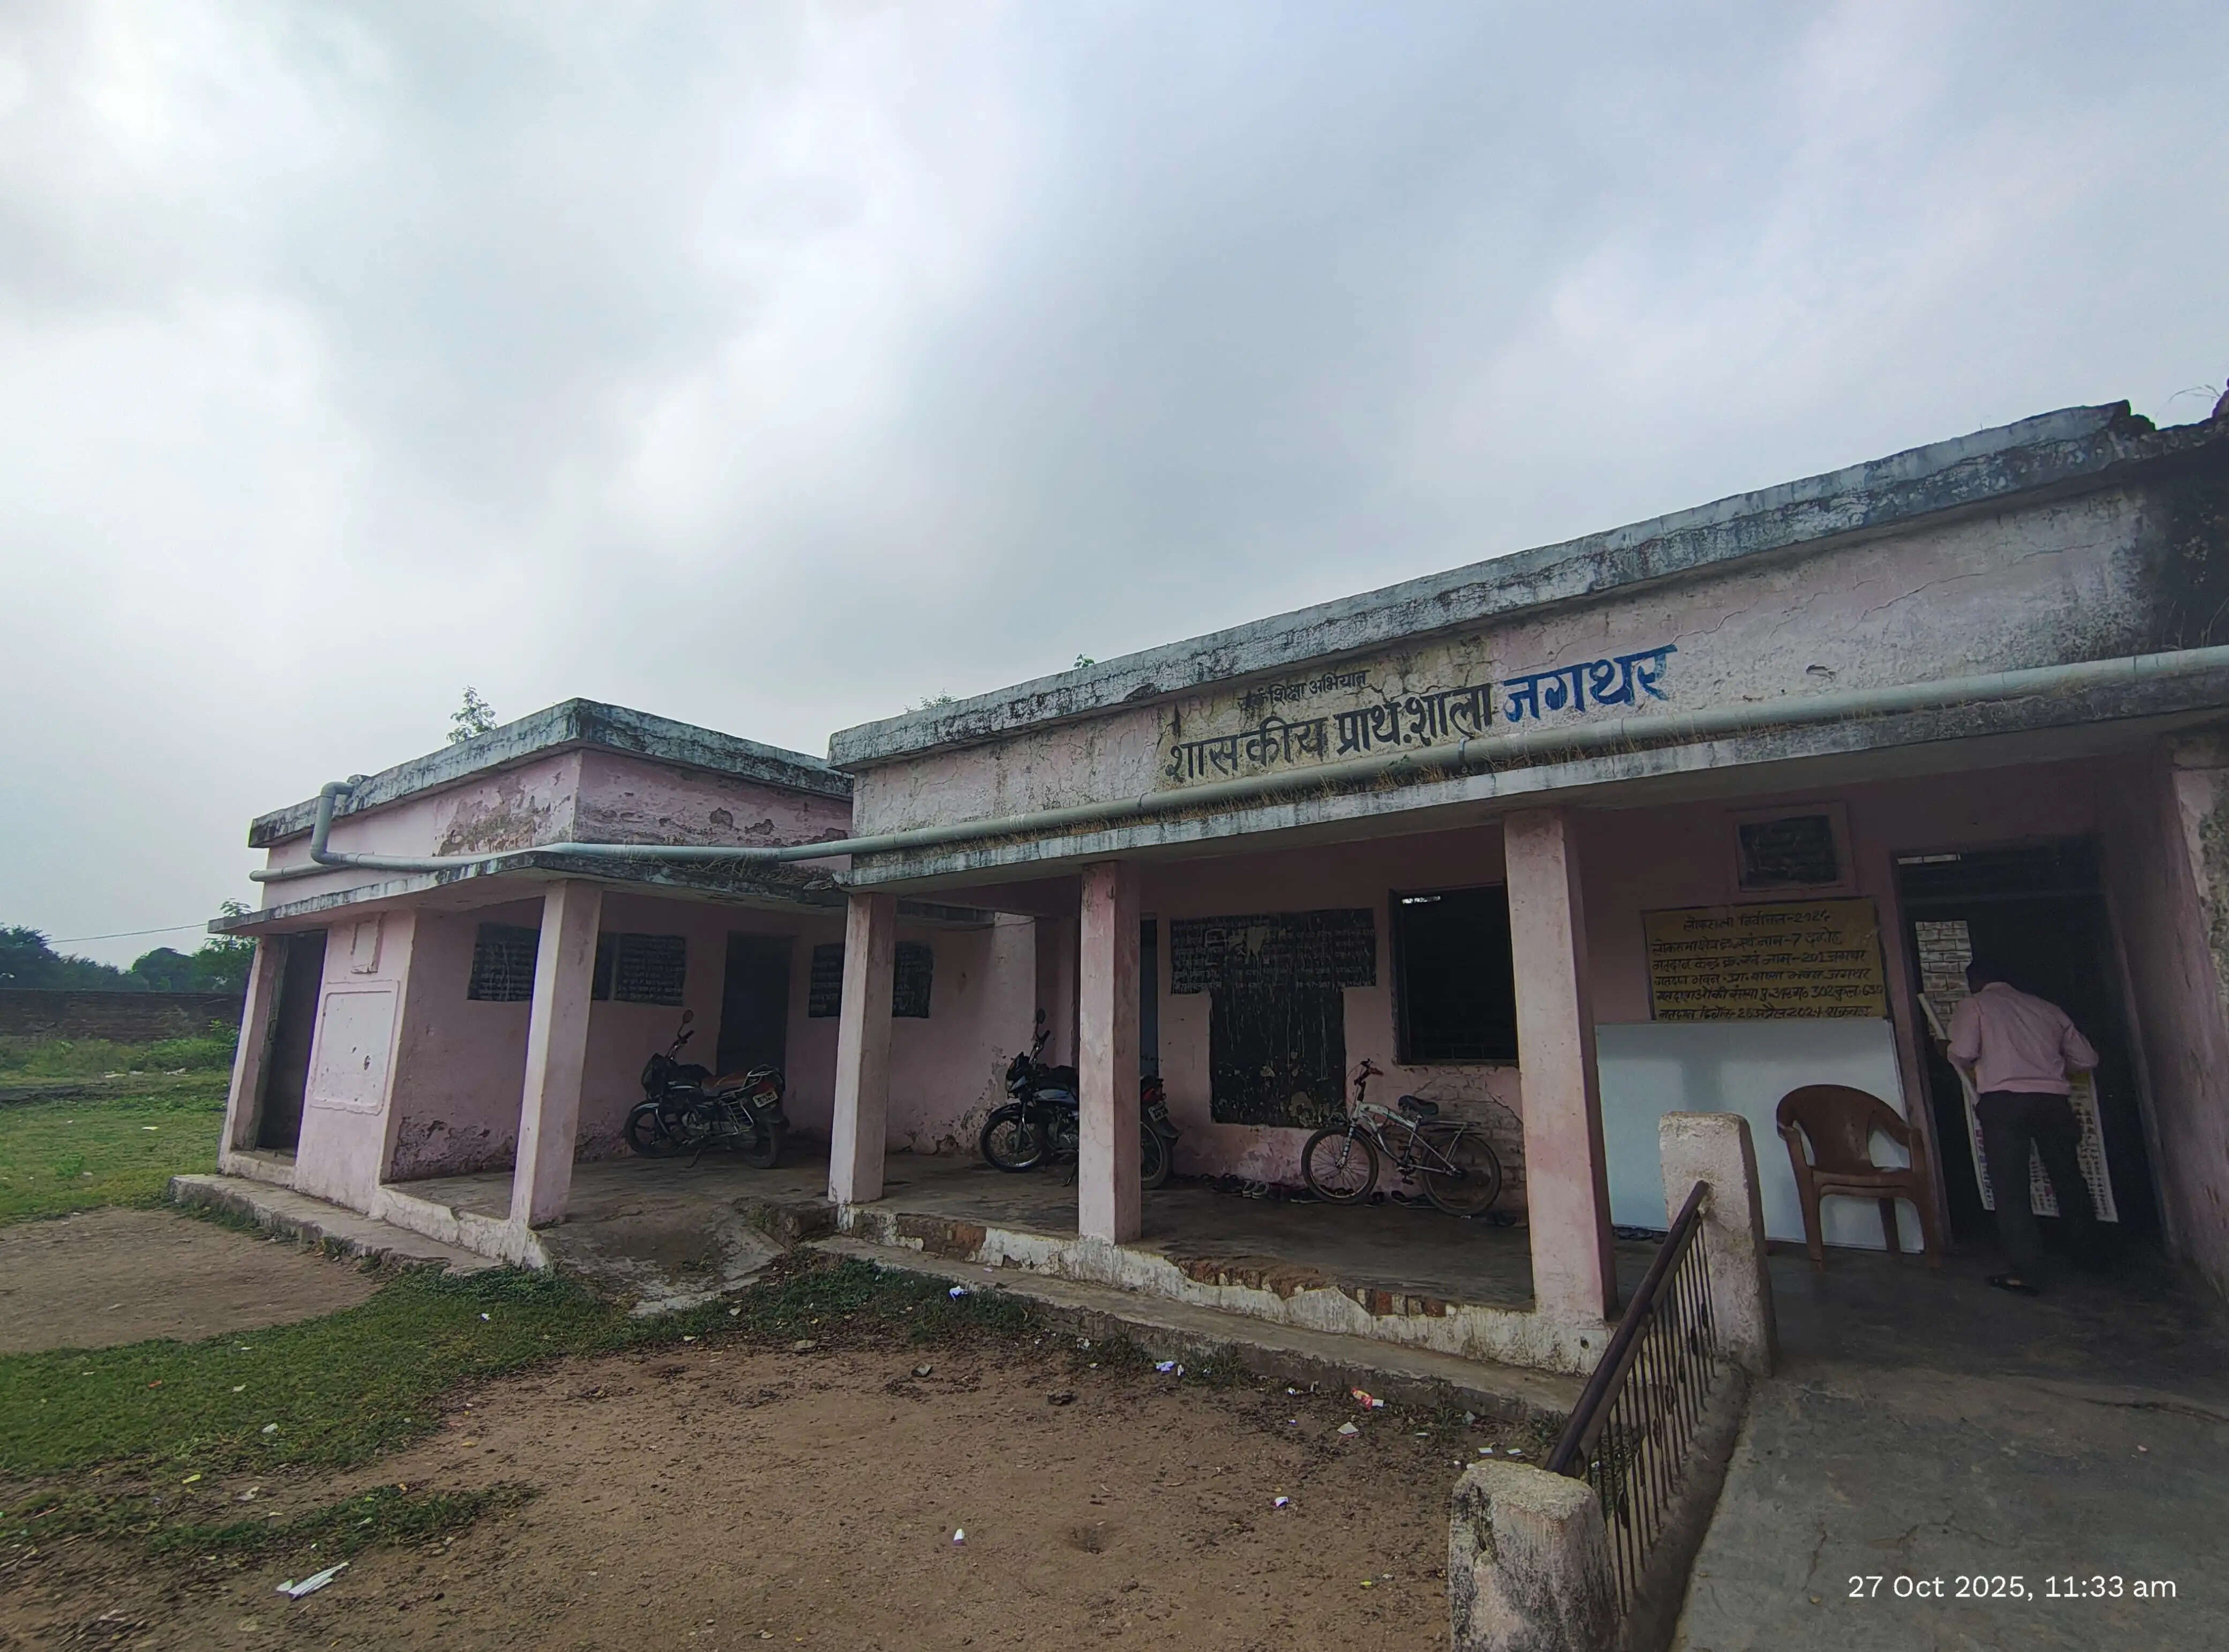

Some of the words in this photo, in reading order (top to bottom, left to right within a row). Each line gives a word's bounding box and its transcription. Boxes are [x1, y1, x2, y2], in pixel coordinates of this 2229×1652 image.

[1165, 716, 1329, 780] शासकीय
[1502, 644, 1678, 723] जगथर
[1266, 683, 1306, 705] शिक्षा
[1308, 670, 1371, 695] अभियान
